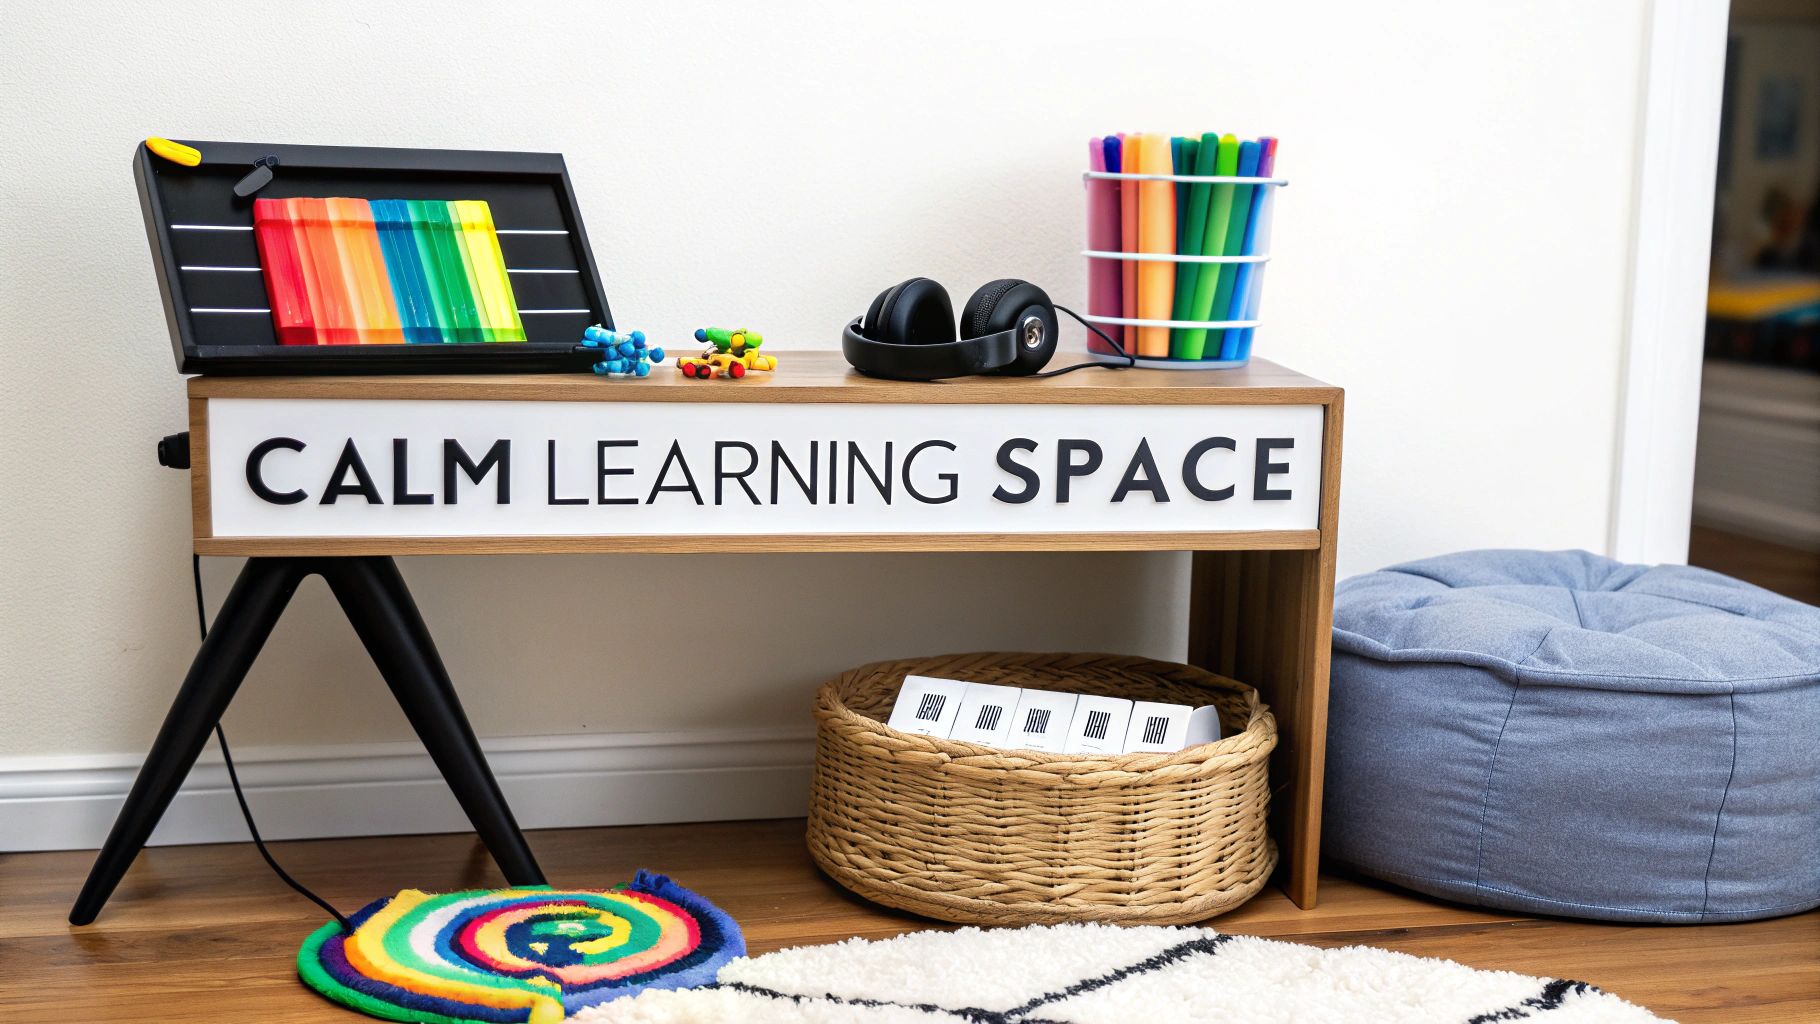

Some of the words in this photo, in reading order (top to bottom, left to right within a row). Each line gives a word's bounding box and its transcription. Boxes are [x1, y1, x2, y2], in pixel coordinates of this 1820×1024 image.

[245, 436, 511, 506] CALM
[547, 439, 959, 506] LEARNING
[991, 436, 1295, 505] SPACE
